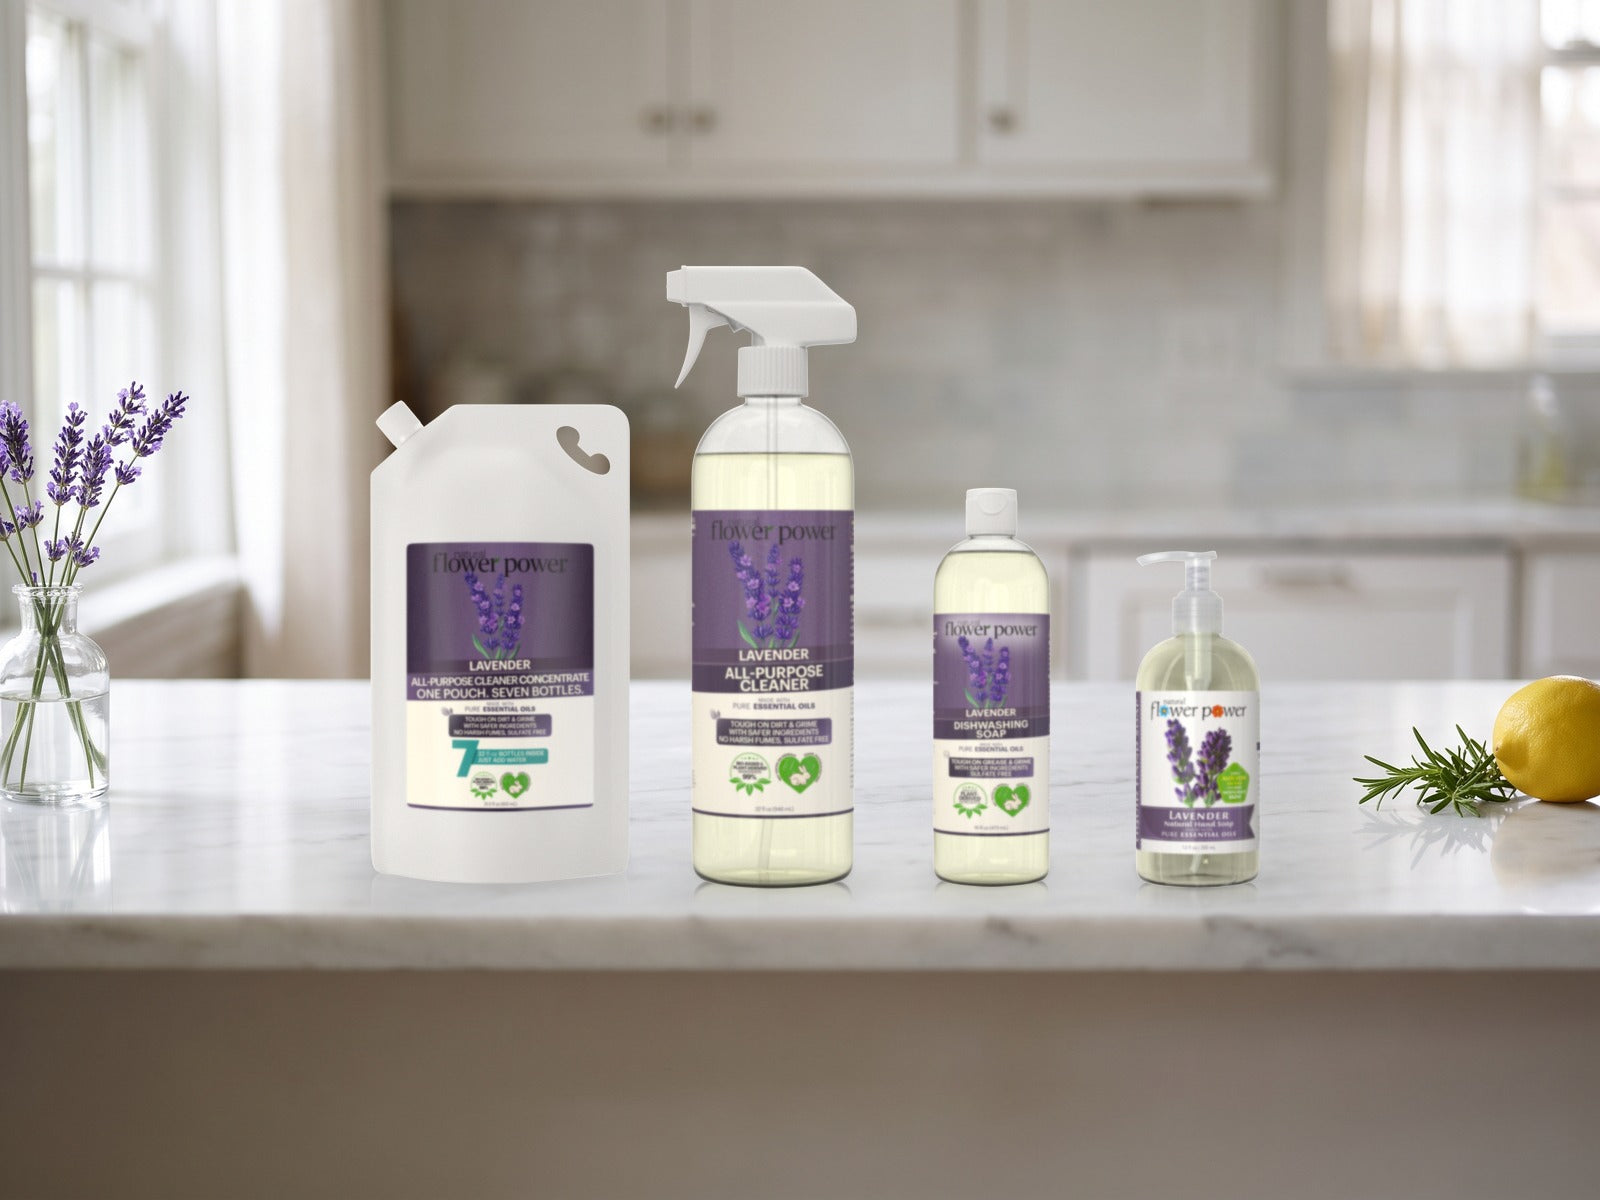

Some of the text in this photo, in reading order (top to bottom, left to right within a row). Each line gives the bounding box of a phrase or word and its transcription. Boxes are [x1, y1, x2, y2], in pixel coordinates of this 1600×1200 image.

[711, 520, 836, 545] flower power
[433, 552, 568, 578] flower power
[946, 621, 1038, 640] flower power
[739, 648, 809, 662] LAVENDER
[469, 660, 531, 671] LAVENDER
[725, 664, 823, 680] ALL-PURPOSE
[411, 672, 590, 686] ALL-PURPOSE CLEANER CONCENTRATE
[740, 678, 809, 692] CLEANER
[416, 684, 584, 699] ONE POUCH. SEVEN BOTTLES.
[966, 708, 1016, 718] LAVENDER
[954, 720, 1028, 730] DISHWASHING
[976, 730, 1006, 738] SOAP
[452, 740, 480, 777] 7
[1169, 810, 1229, 820] LAVENDER
